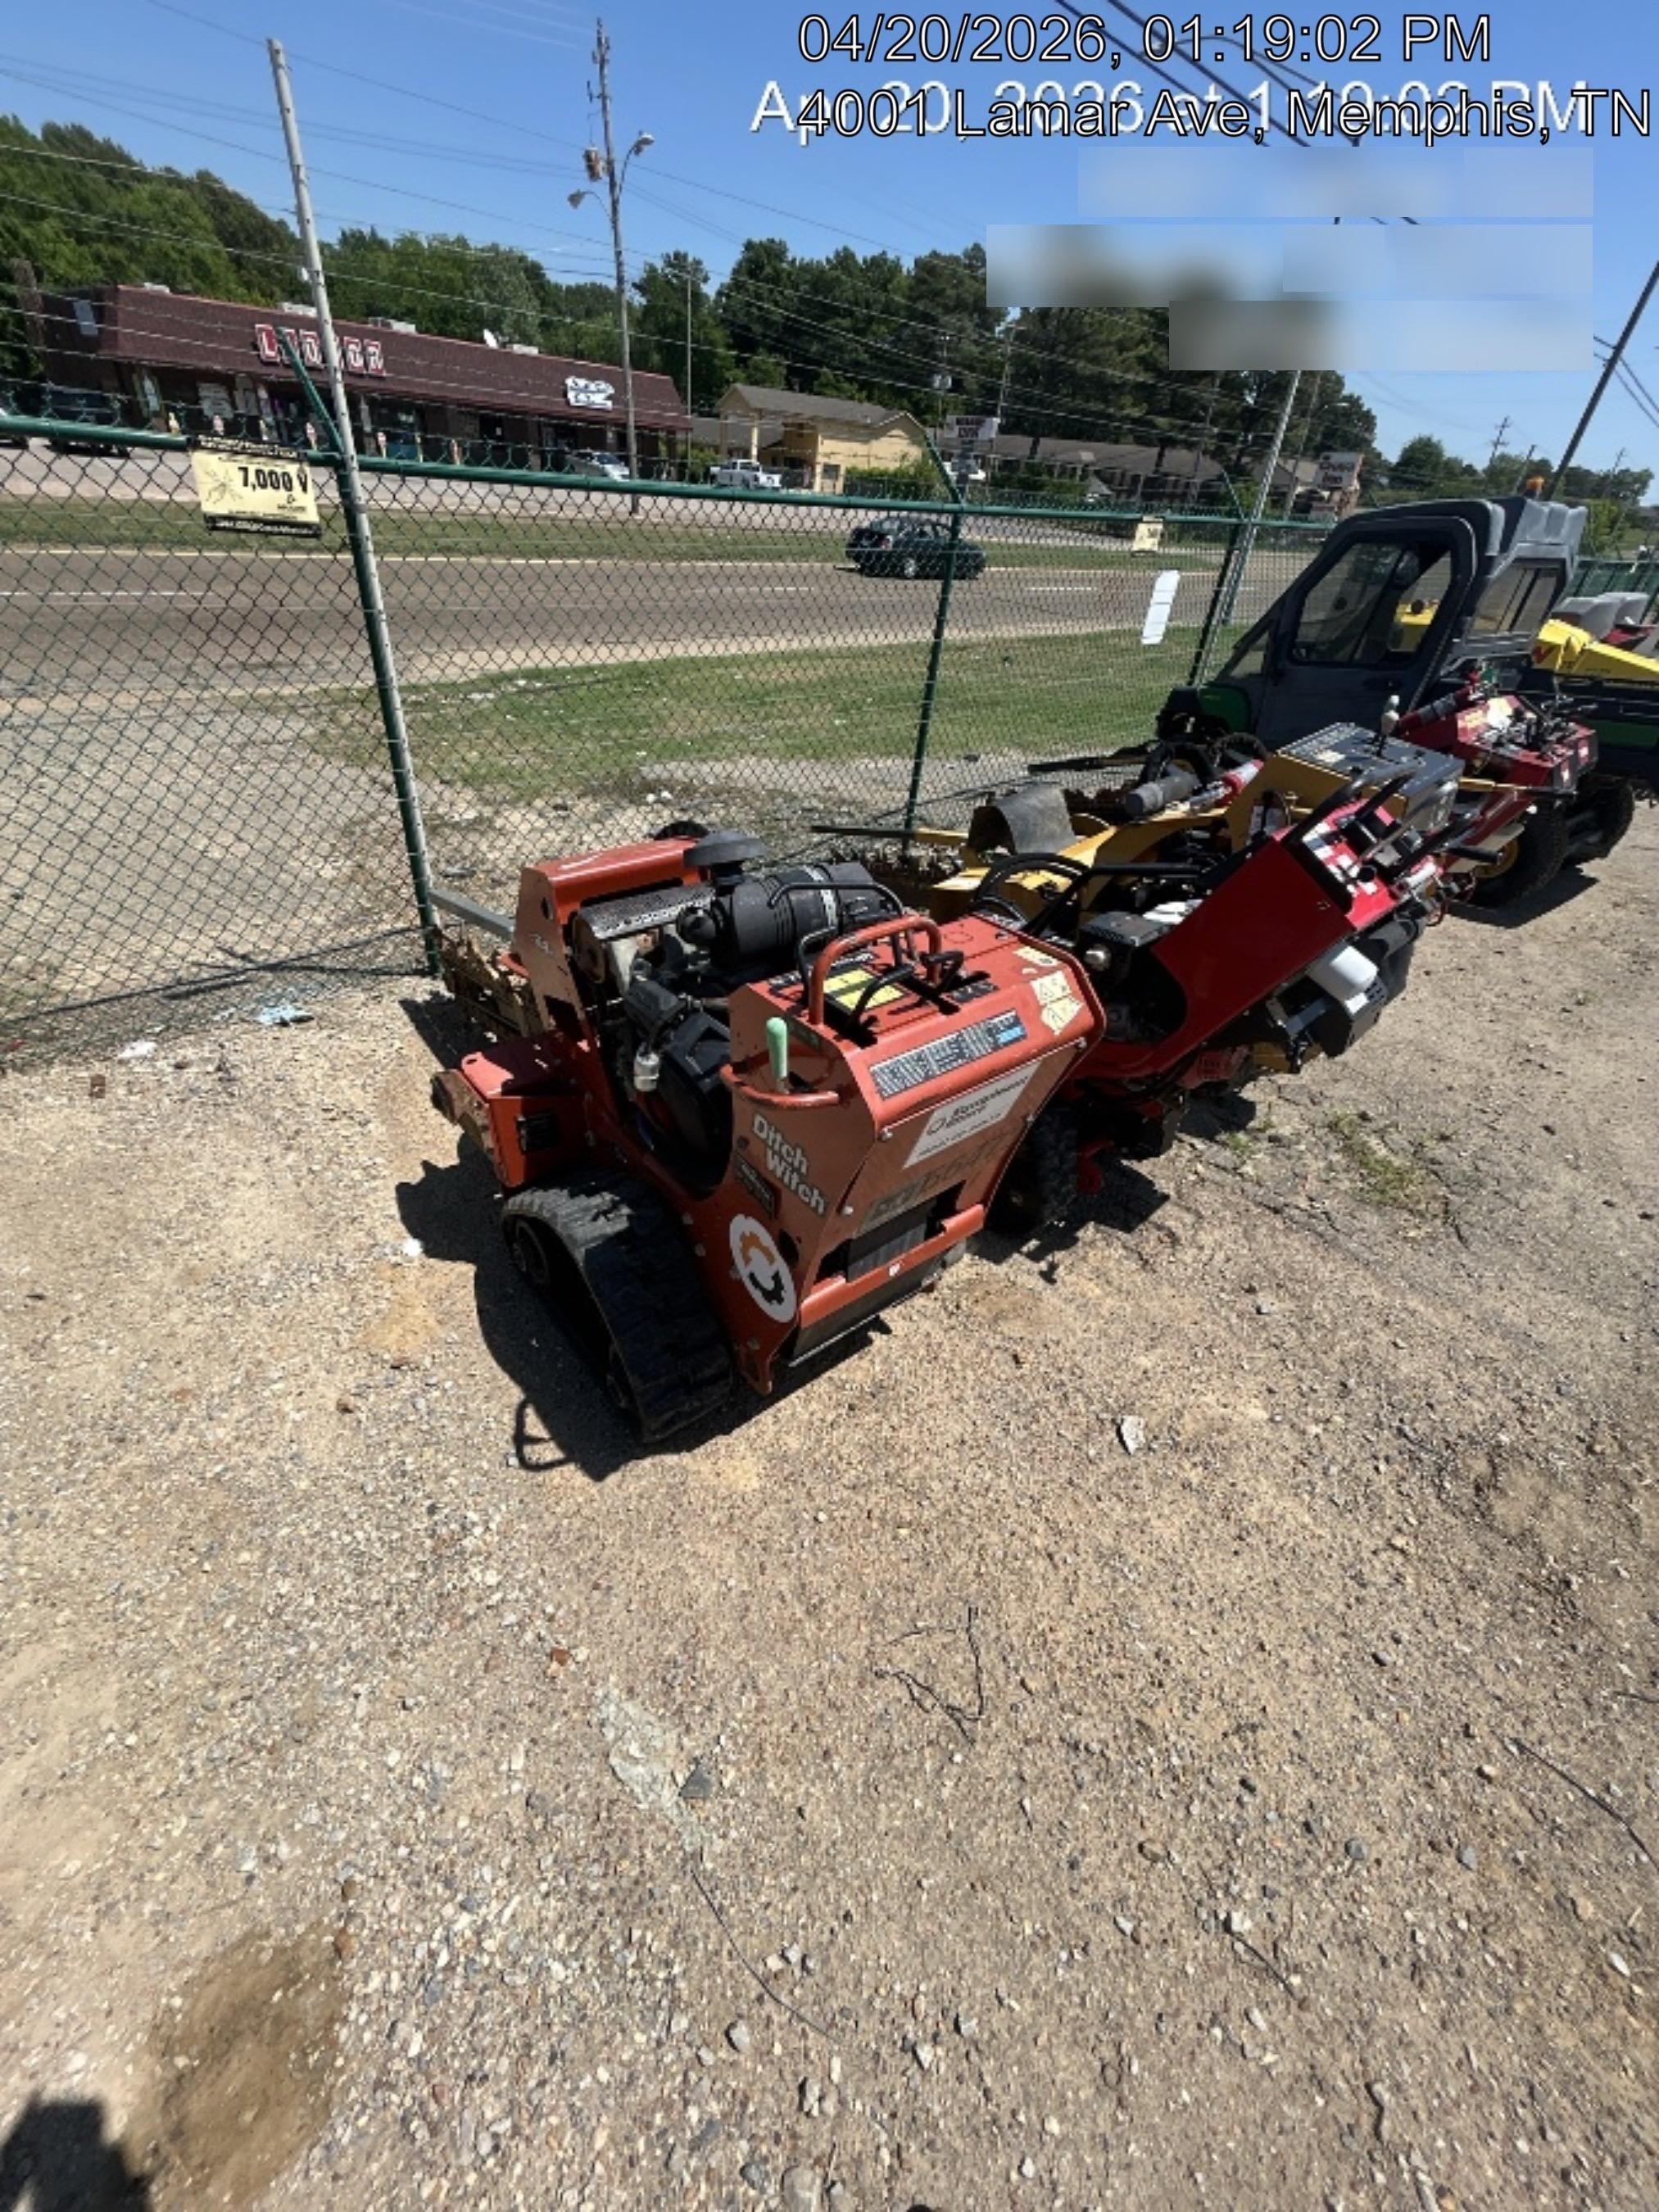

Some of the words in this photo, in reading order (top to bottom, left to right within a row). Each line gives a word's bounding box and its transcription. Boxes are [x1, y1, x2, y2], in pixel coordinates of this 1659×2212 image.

[257, 326, 386, 375] LQOR
[238, 465, 293, 492] 7,000
[297, 469, 308, 494] V
[753, 1113, 808, 1176] Ditch
[766, 1145, 826, 1215] Witch
